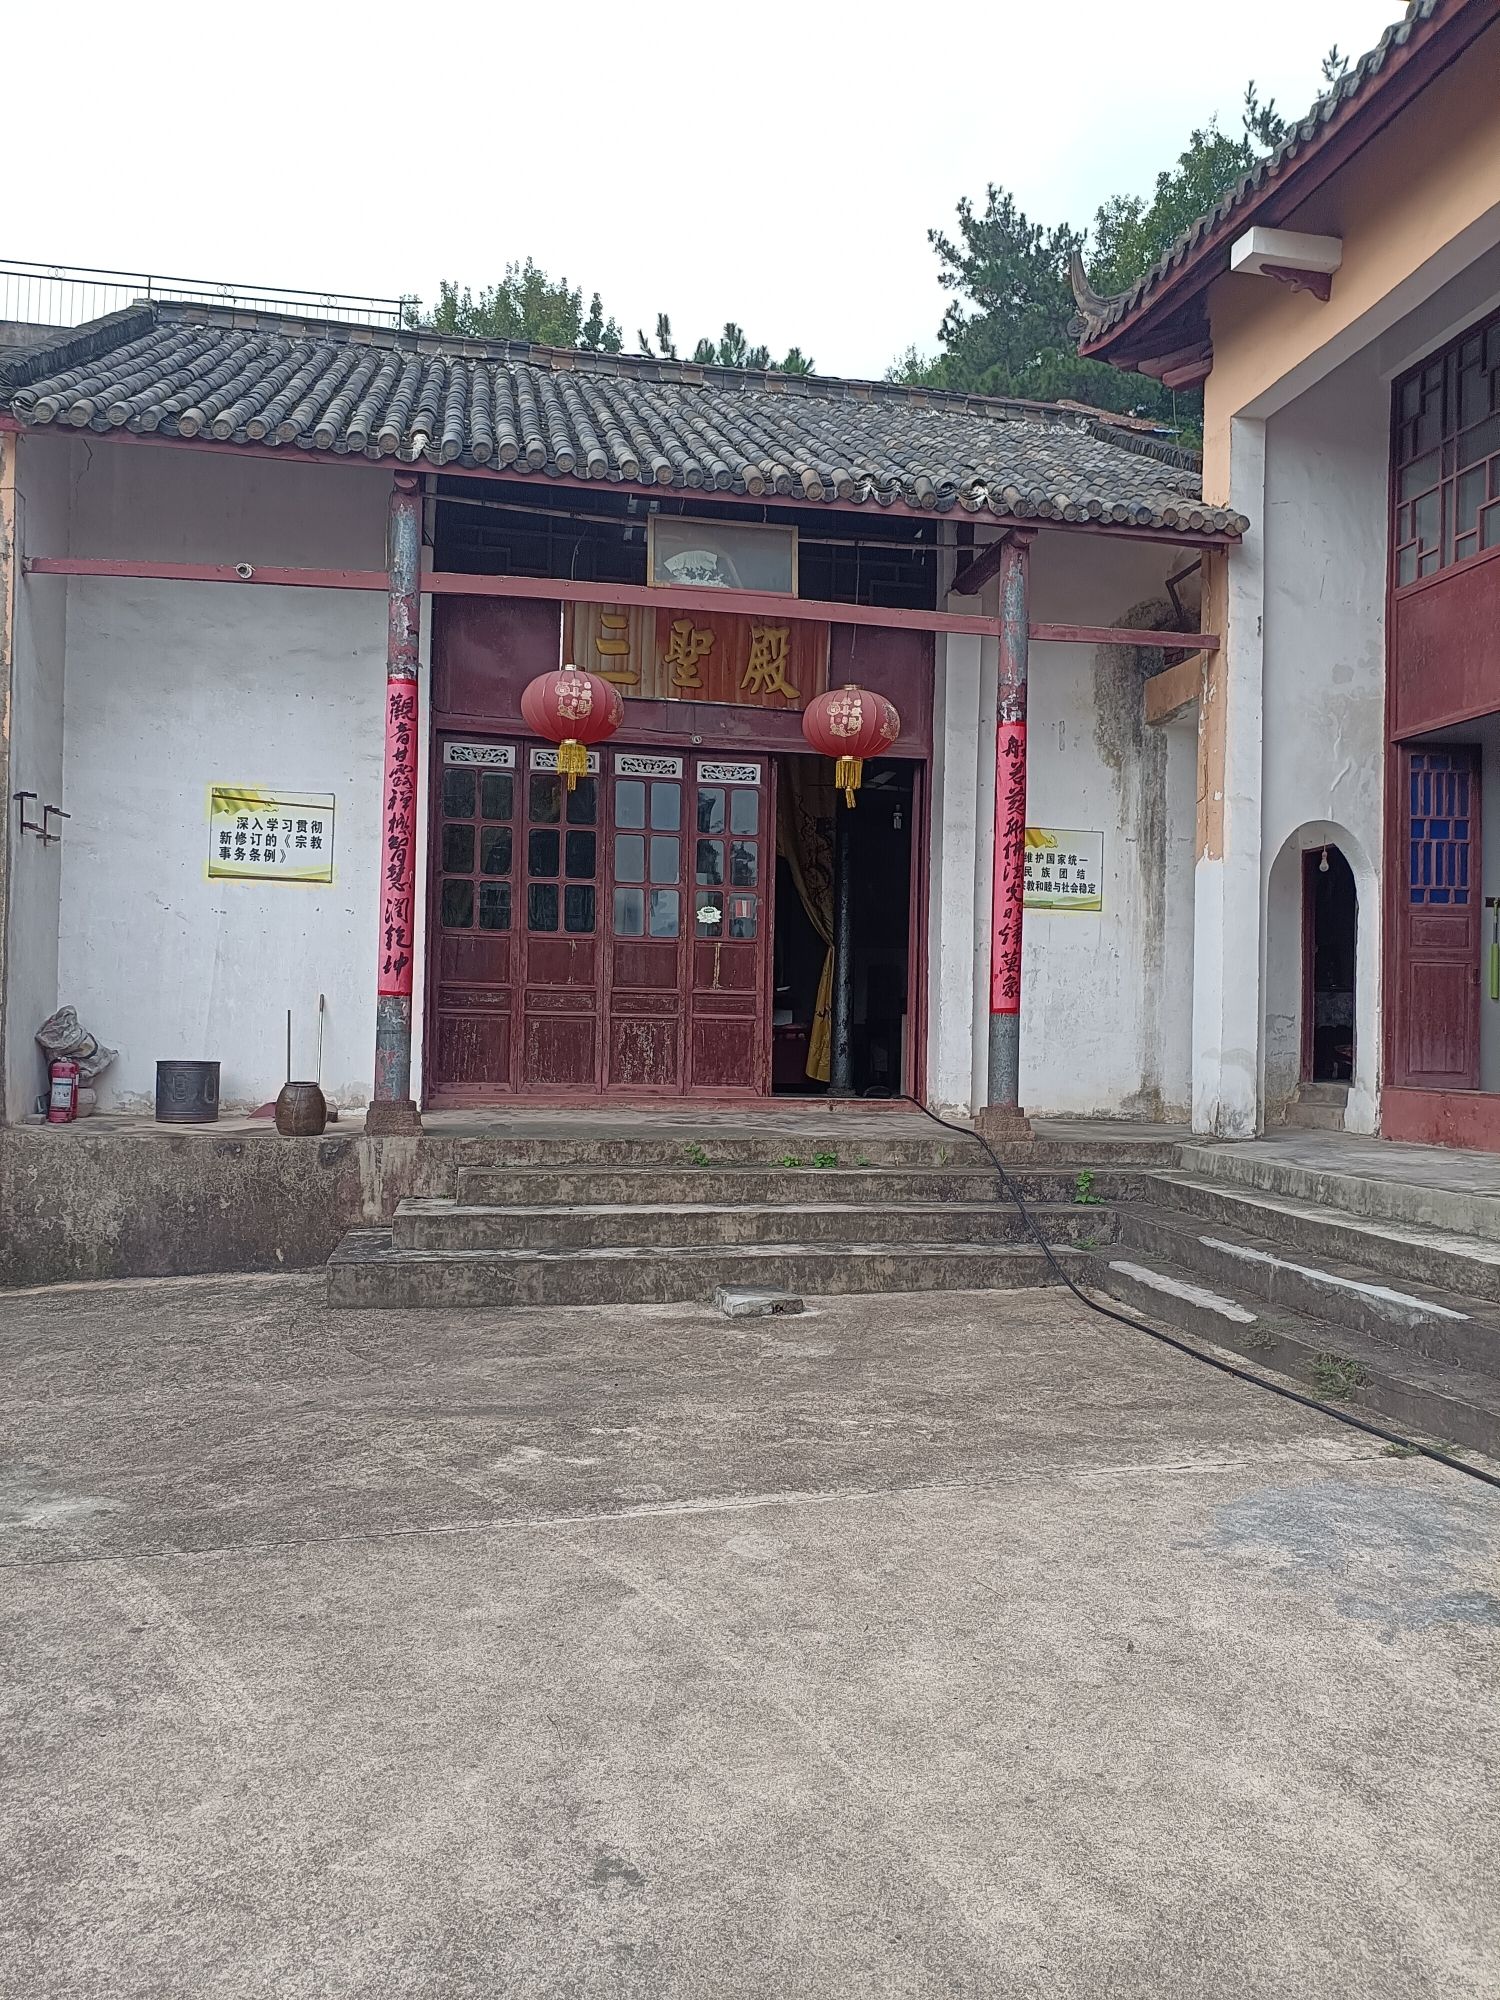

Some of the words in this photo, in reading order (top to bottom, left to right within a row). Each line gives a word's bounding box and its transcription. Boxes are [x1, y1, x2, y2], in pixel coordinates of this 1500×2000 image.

[592, 613, 800, 699] 三聖殿
[236, 816, 323, 834] 深入学习贯彻
[219, 831, 323, 850] 新修订的《宗教
[219, 846, 287, 863] 事务条例》
[1024, 866, 1086, 880] 民族团结
